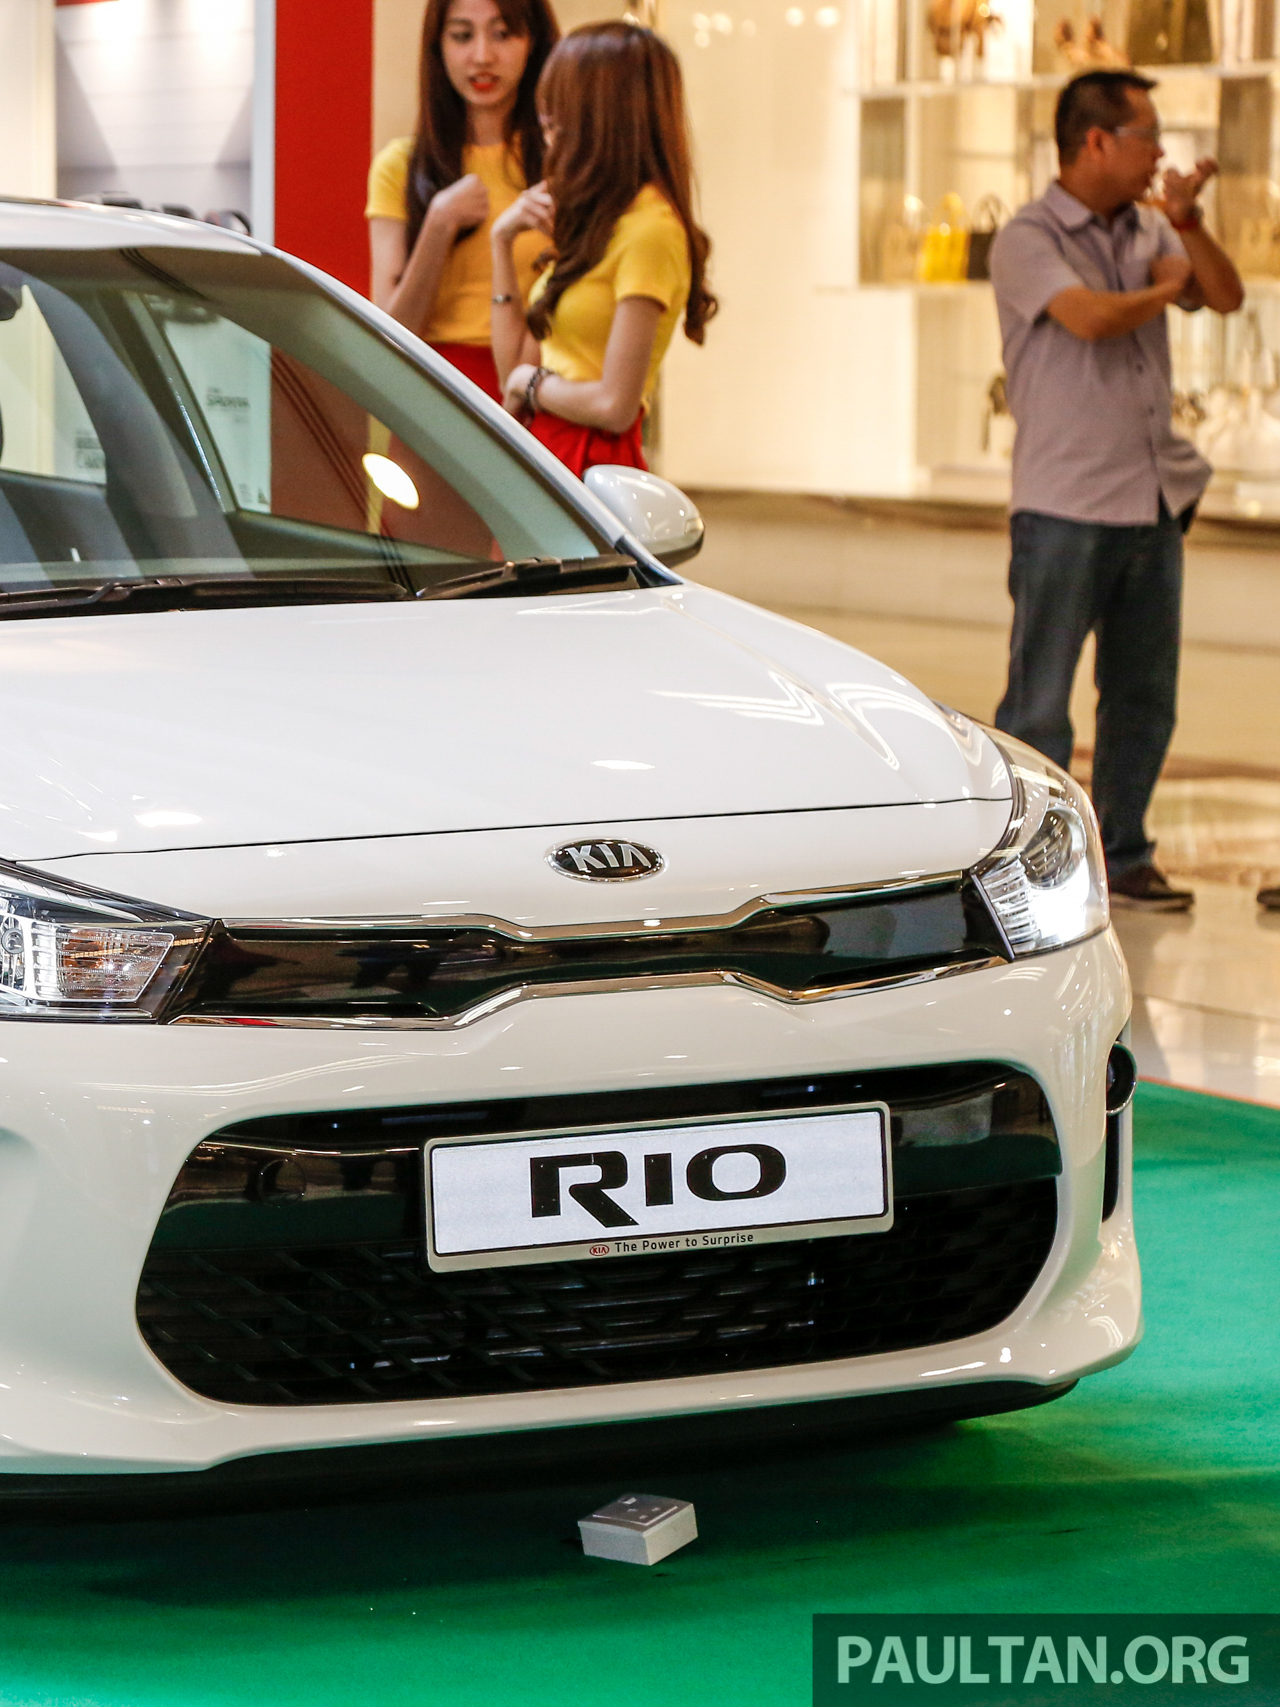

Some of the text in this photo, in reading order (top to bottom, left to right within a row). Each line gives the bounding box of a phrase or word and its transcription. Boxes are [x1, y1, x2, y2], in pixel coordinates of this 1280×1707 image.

[563, 843, 653, 873] KIA
[529, 1143, 787, 1229] RIO
[591, 1233, 754, 1255] KIA The Power to Surprise
